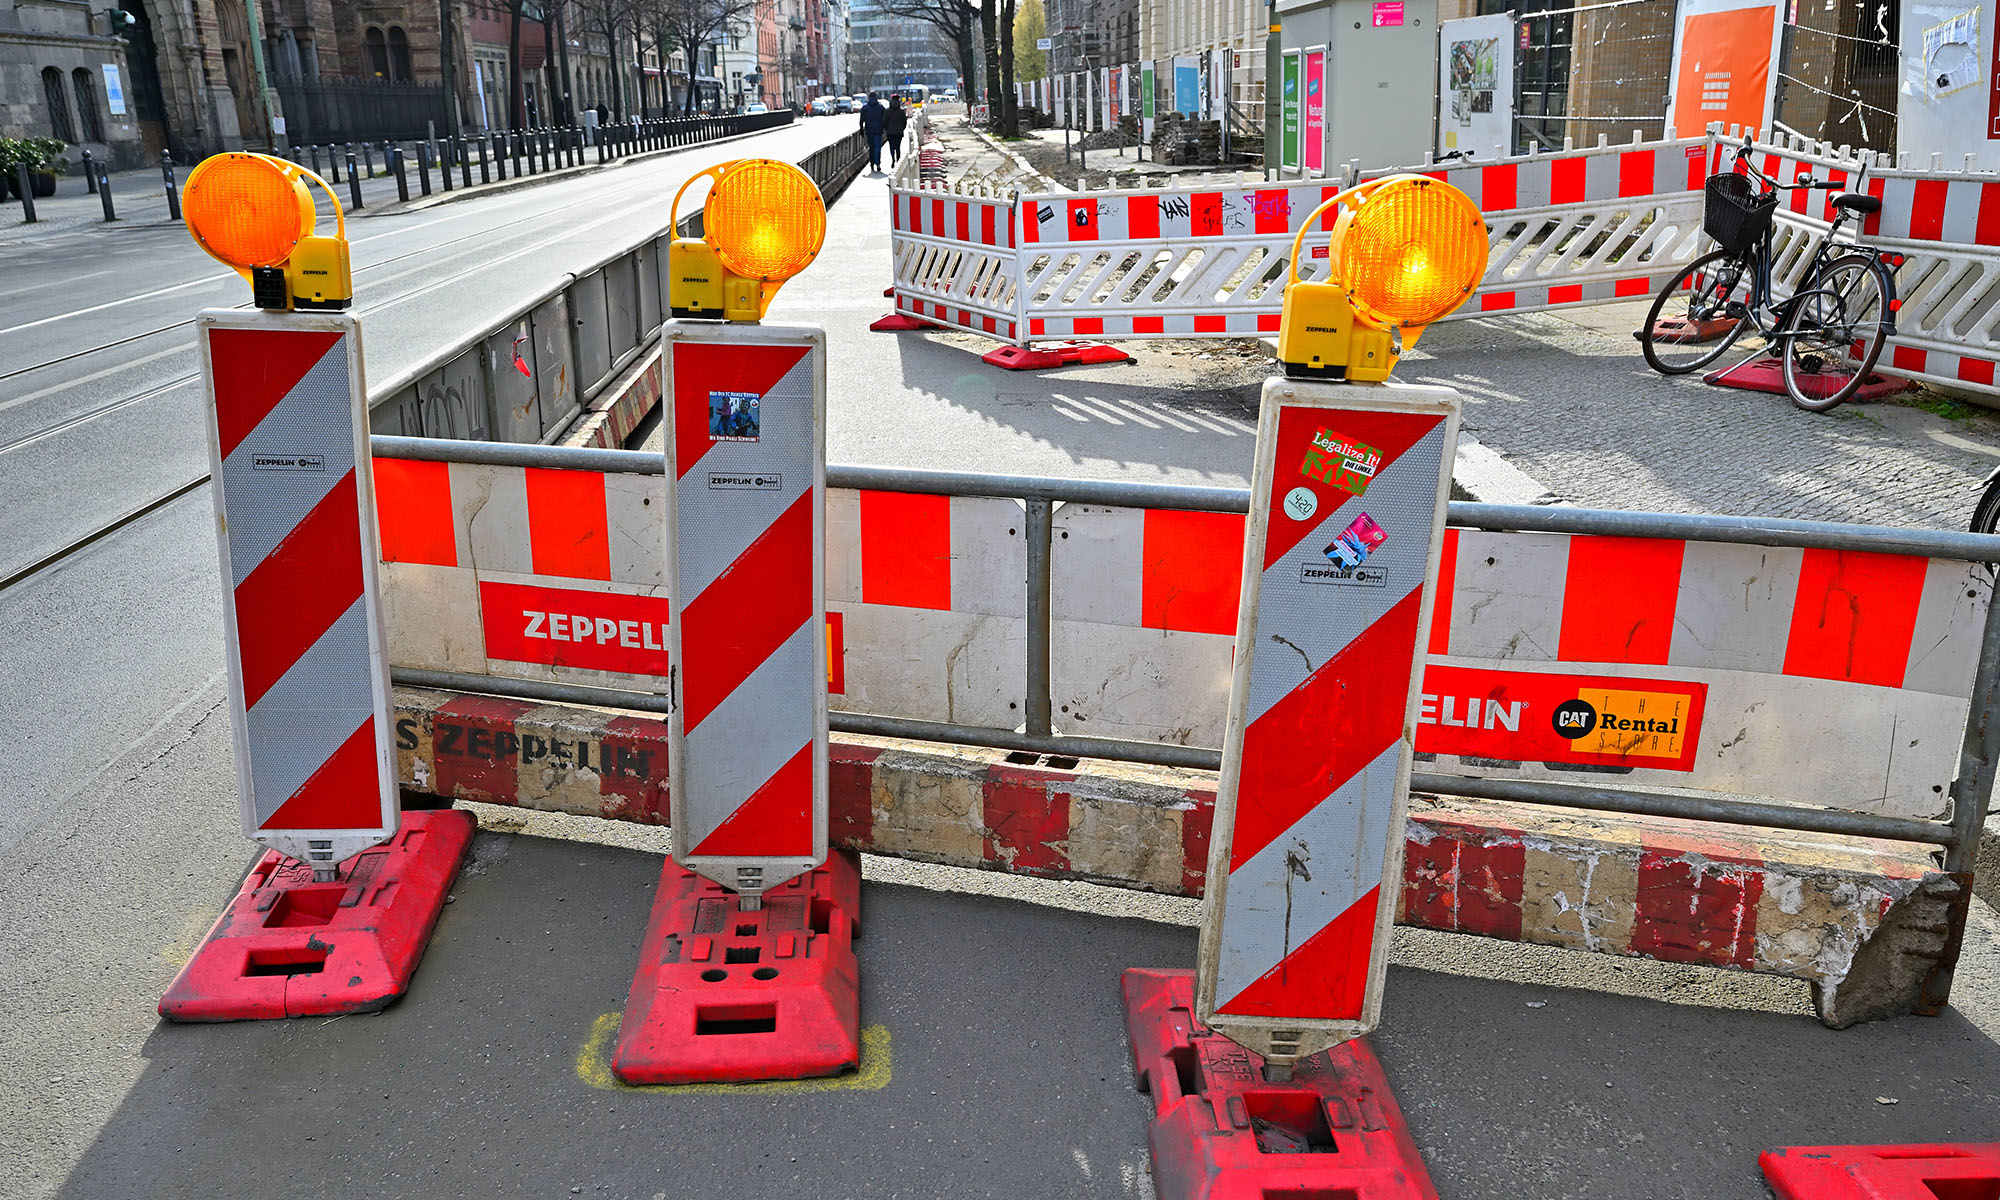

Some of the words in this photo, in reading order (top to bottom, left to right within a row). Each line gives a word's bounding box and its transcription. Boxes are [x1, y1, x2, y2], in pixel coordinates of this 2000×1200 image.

[1305, 326, 1338, 334] ZEPPELIN
[1312, 431, 1365, 462] Legalize
[1364, 453, 1381, 468] It!
[1345, 460, 1357, 470] DIE
[711, 477, 752, 485] ZEPPELIN
[1603, 695, 1681, 717] THE
[1558, 710, 1589, 729] CAT
[1599, 712, 1679, 734] Rental
